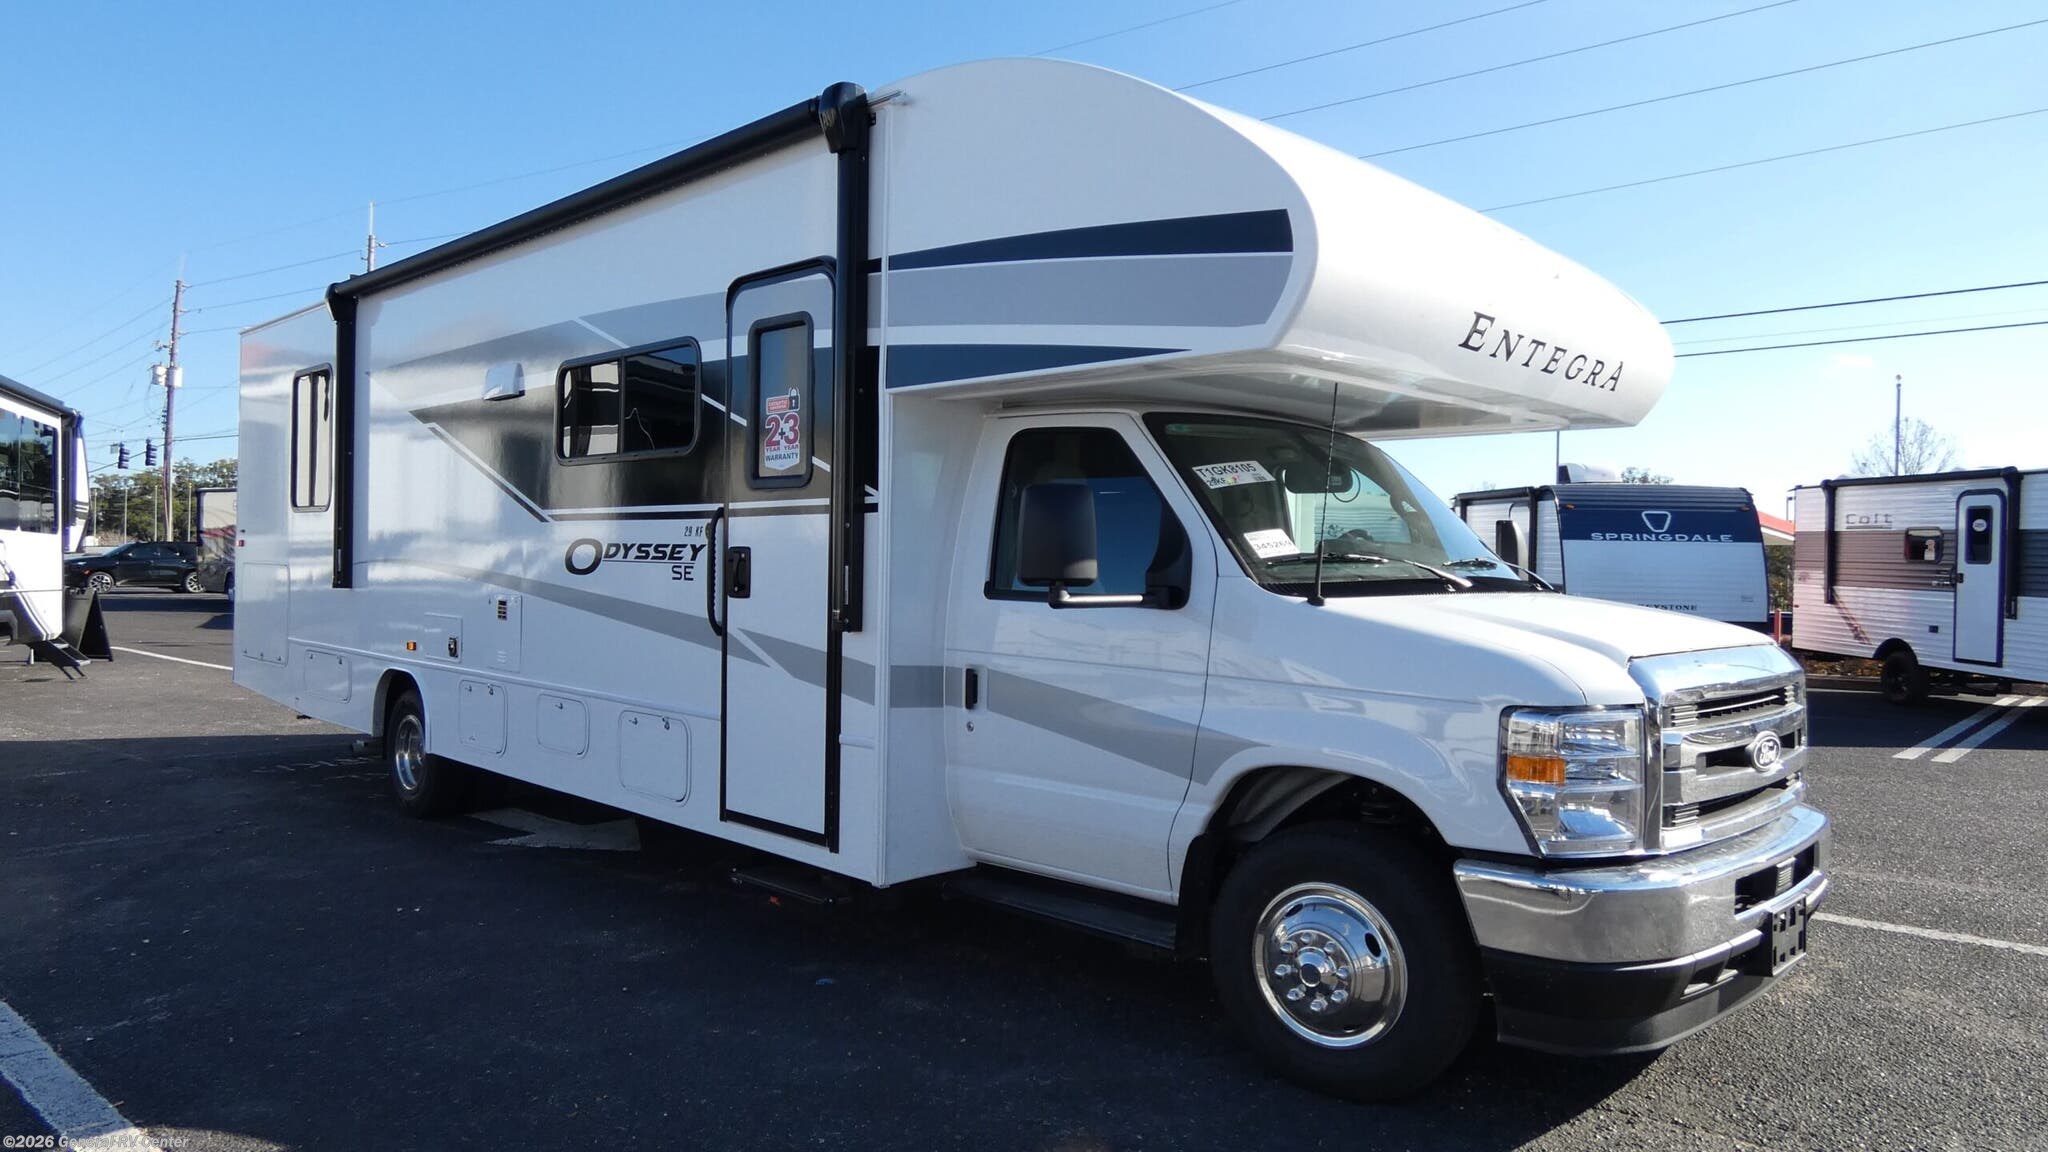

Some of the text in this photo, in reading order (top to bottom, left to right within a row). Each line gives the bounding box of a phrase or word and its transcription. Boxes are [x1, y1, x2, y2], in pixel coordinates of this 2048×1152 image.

[1458, 311, 1624, 392] ENTEGRA
[784, 443, 799, 451] YEAR
[765, 452, 799, 463] WARRANTY
[1846, 513, 1893, 524] Colt
[684, 526, 693, 537] 29
[1591, 532, 1733, 543] SPRINGDALE
[564, 537, 707, 576] ODYSSEY
[671, 565, 694, 581] SE
[1637, 603, 1697, 612] YSTONE
